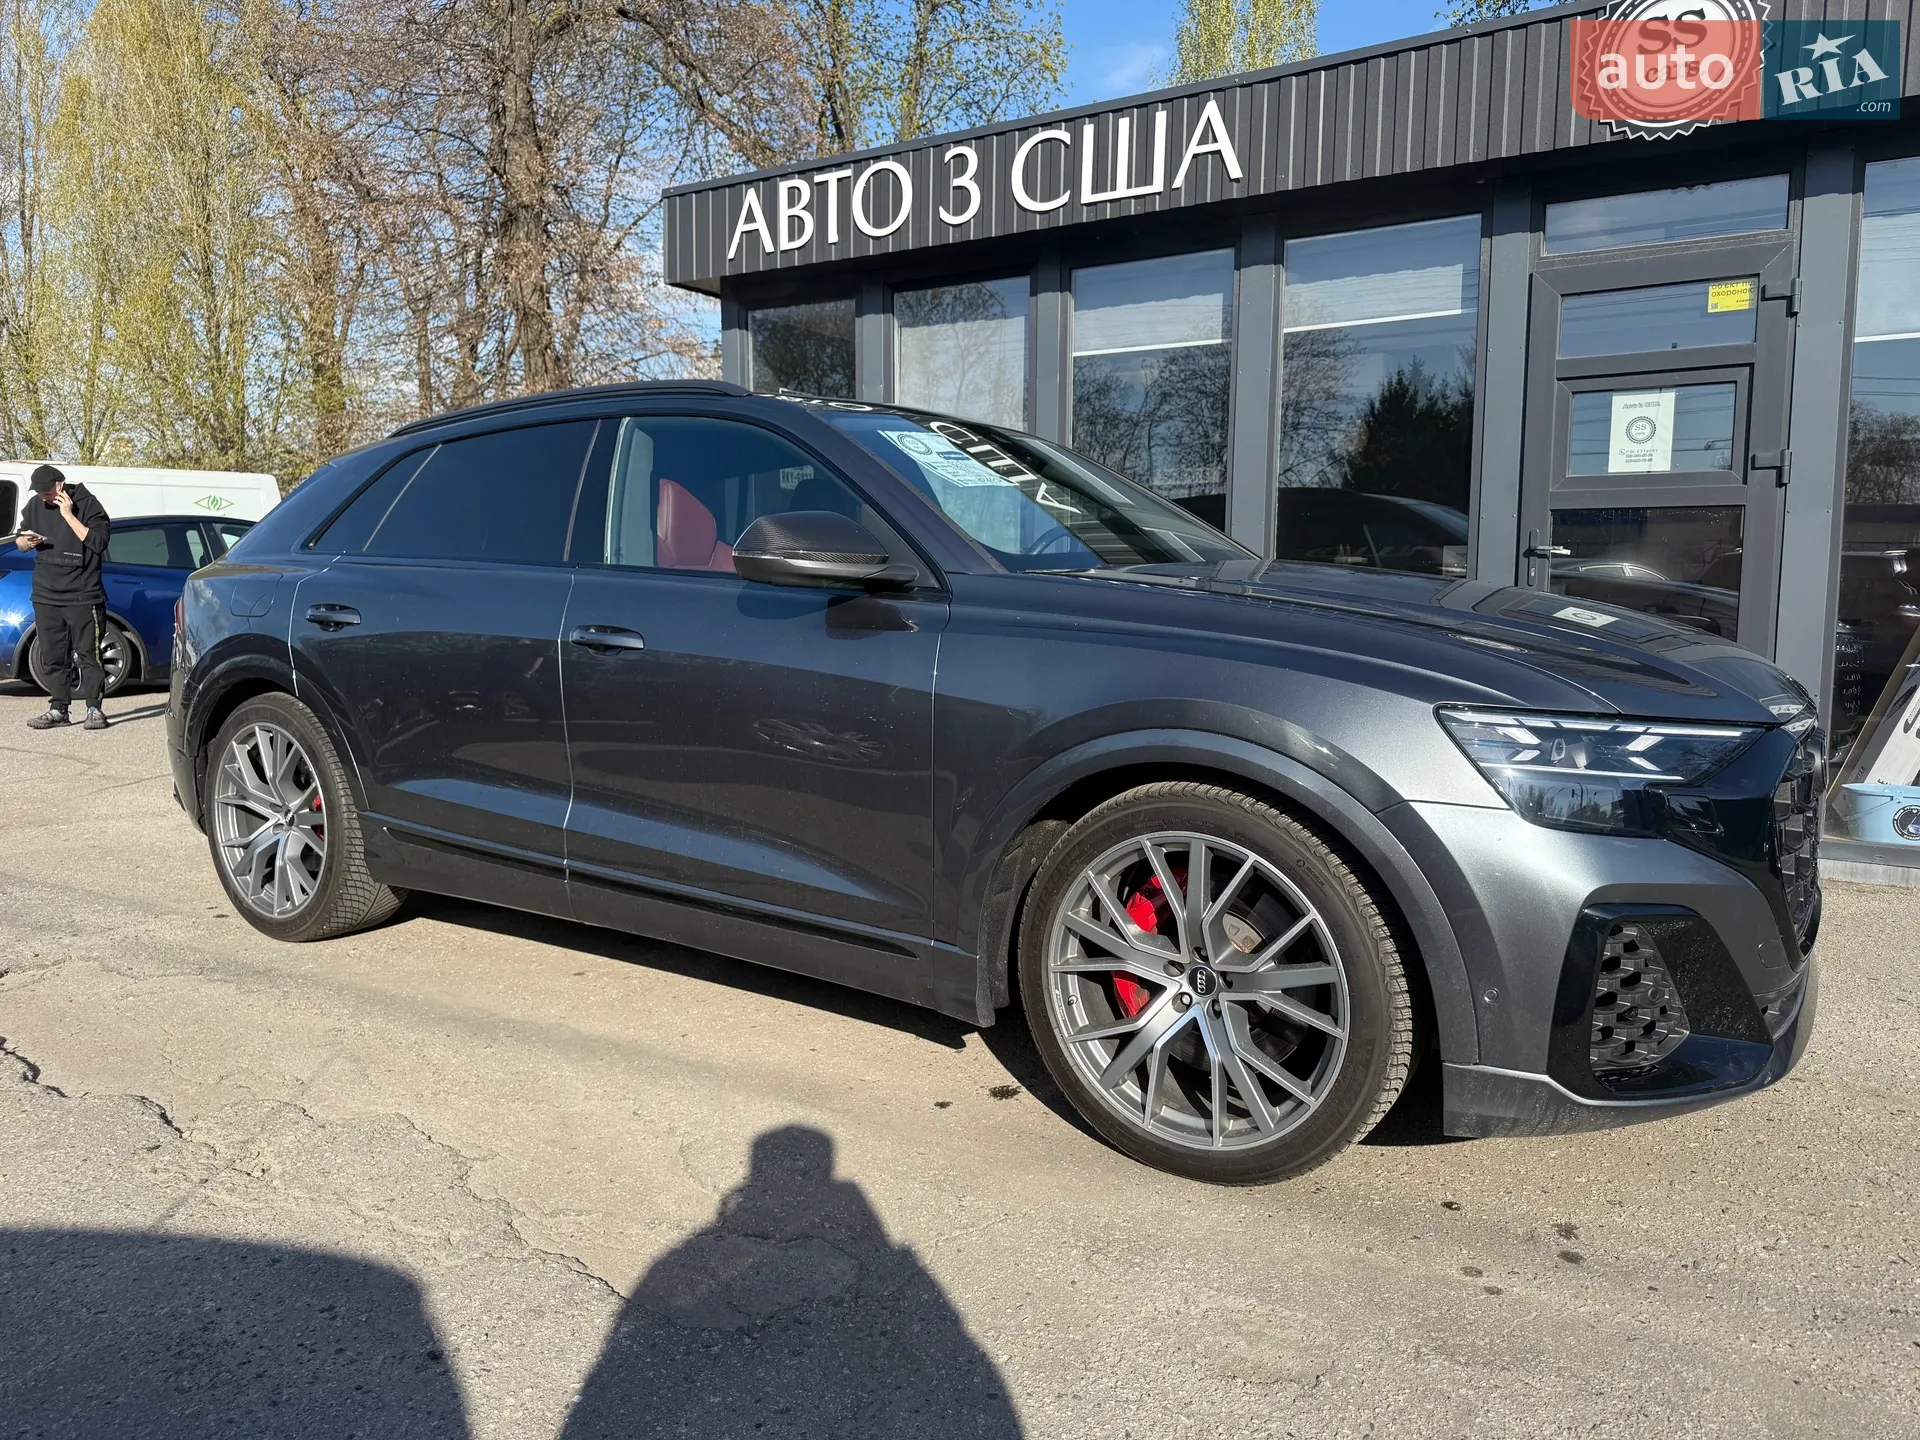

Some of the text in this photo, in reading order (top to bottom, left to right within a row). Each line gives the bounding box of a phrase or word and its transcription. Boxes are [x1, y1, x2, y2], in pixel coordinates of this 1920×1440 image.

[1636, 7, 1708, 55] SS
[727, 160, 913, 260] АВТО
[1010, 99, 1243, 212] США
[1634, 423, 1647, 431] SS
